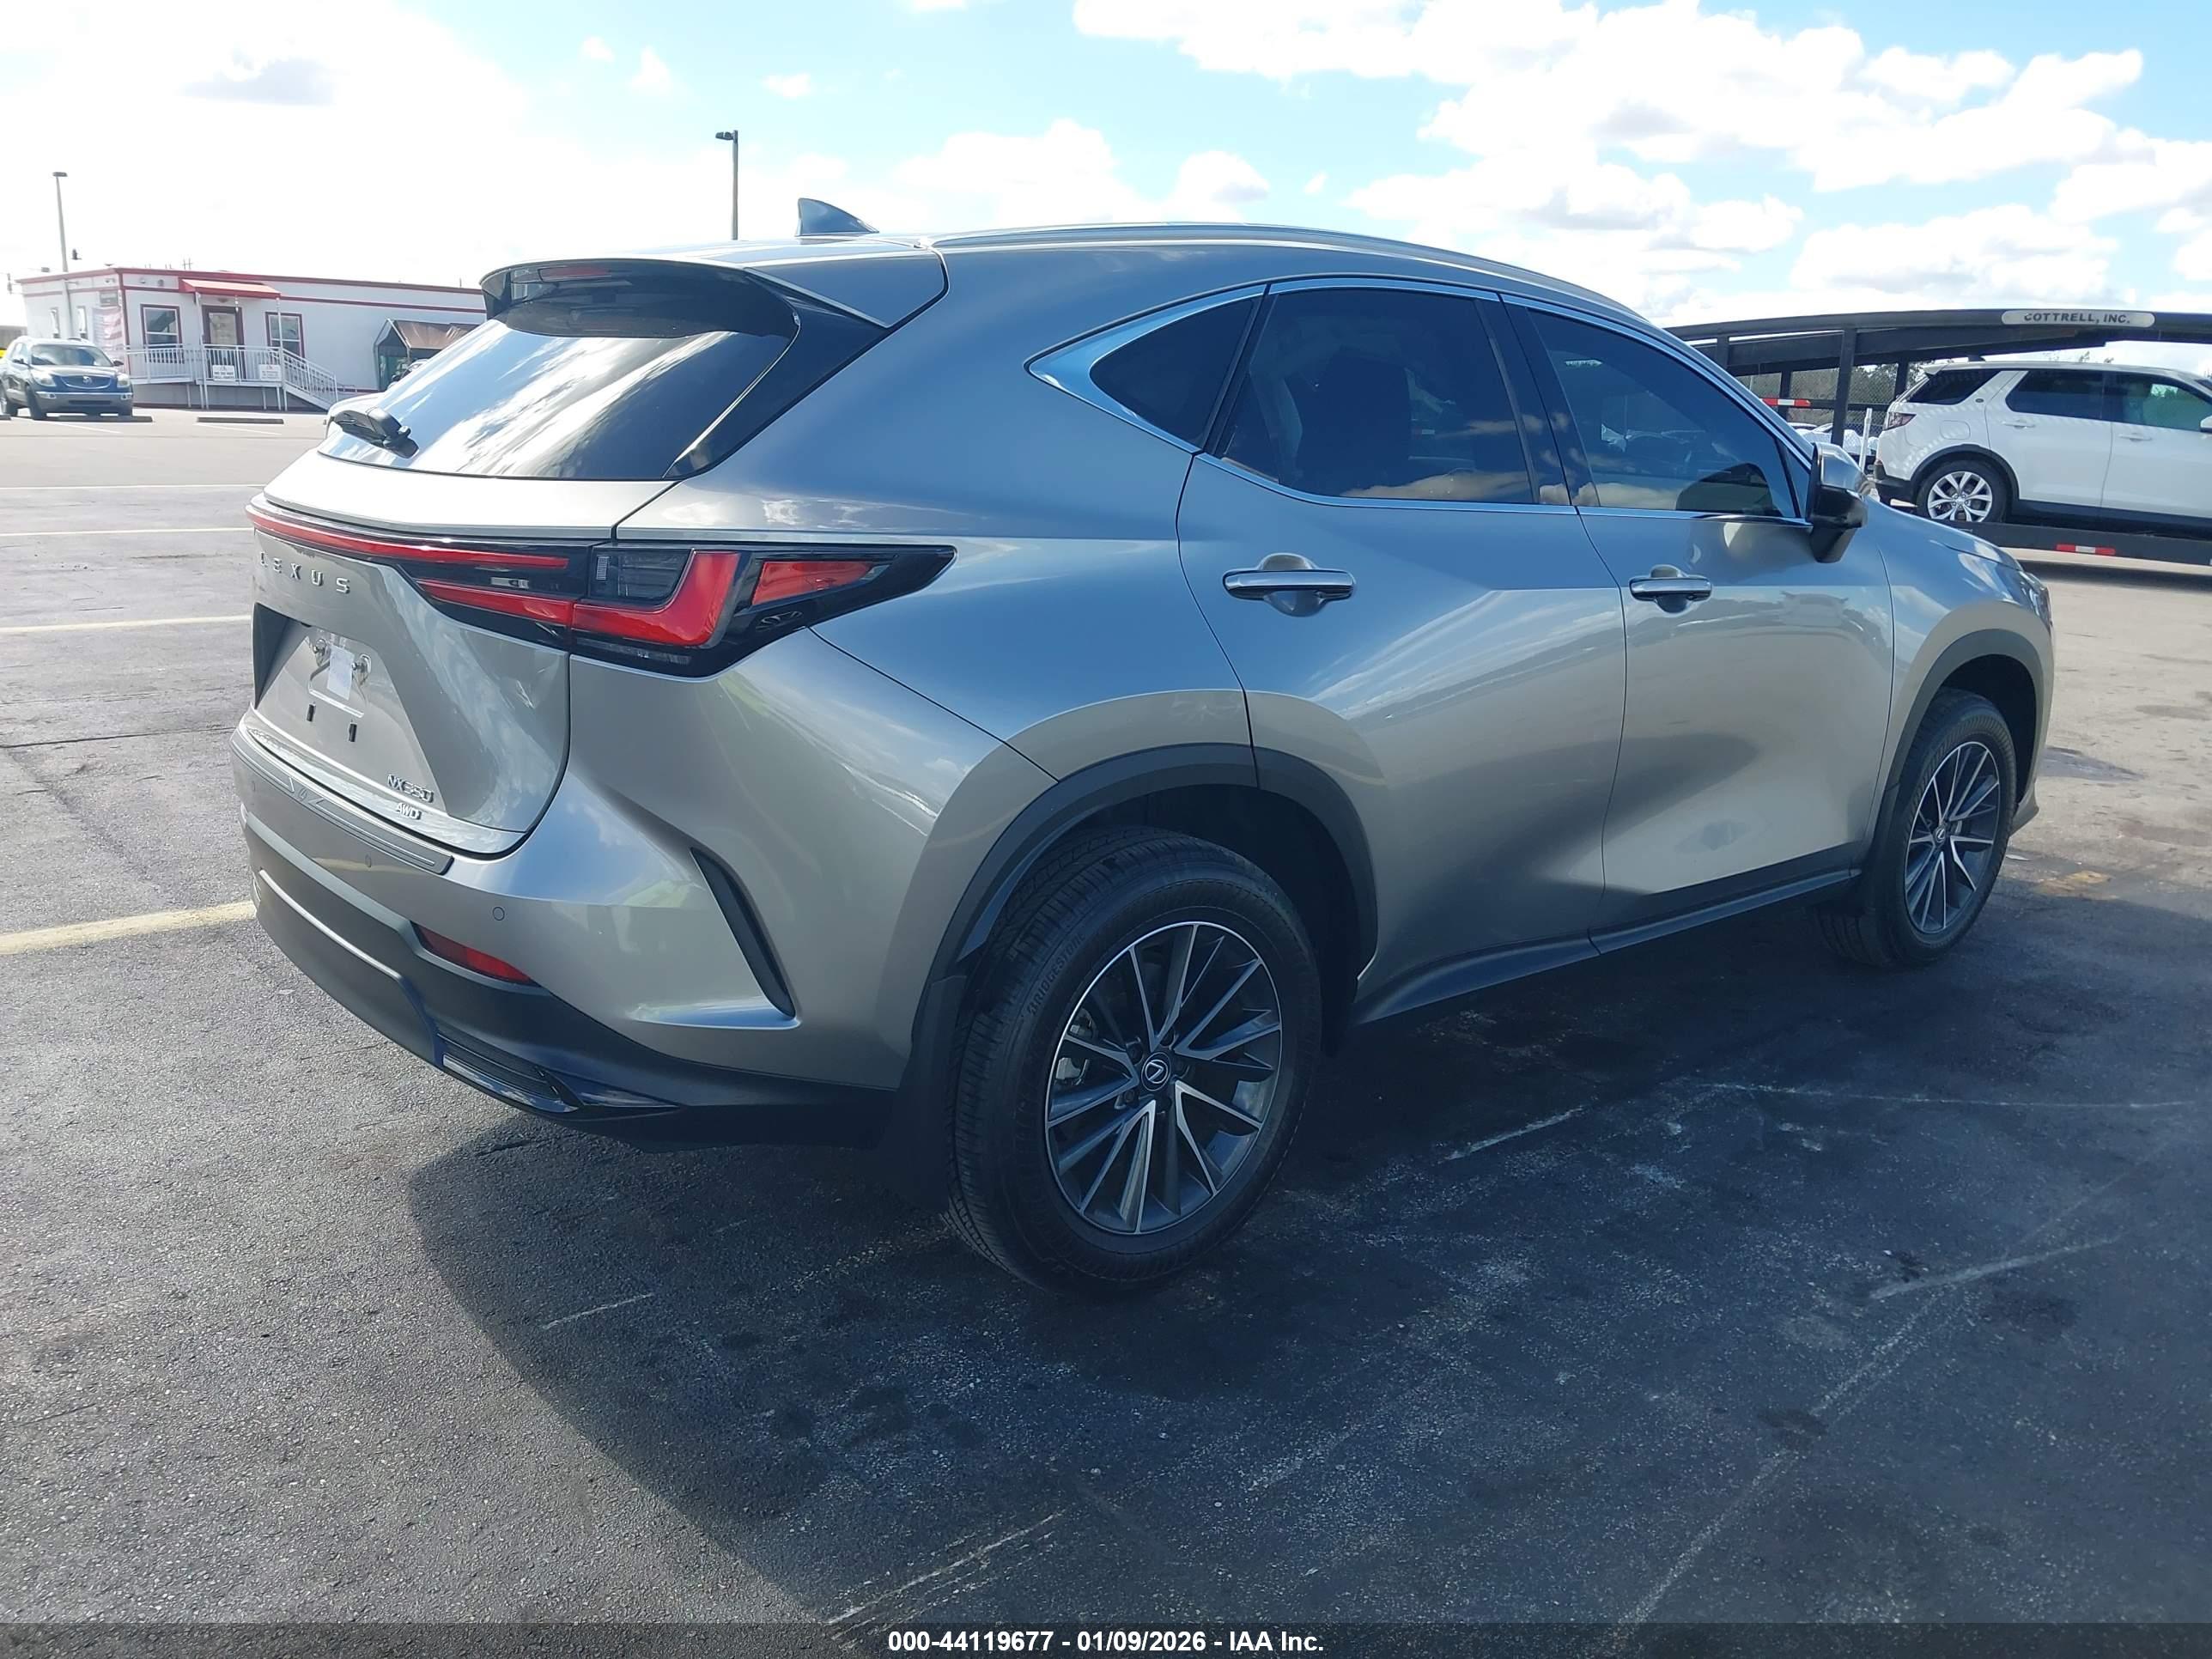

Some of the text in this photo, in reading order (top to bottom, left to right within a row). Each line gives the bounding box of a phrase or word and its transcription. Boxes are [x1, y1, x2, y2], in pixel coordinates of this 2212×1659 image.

[2024, 312, 2130, 325] COTTRELL, INC.
[259, 550, 350, 594] LEXUS
[396, 802, 422, 820] AWD
[1026, 932, 1086, 1015] BRIDGESTONE
